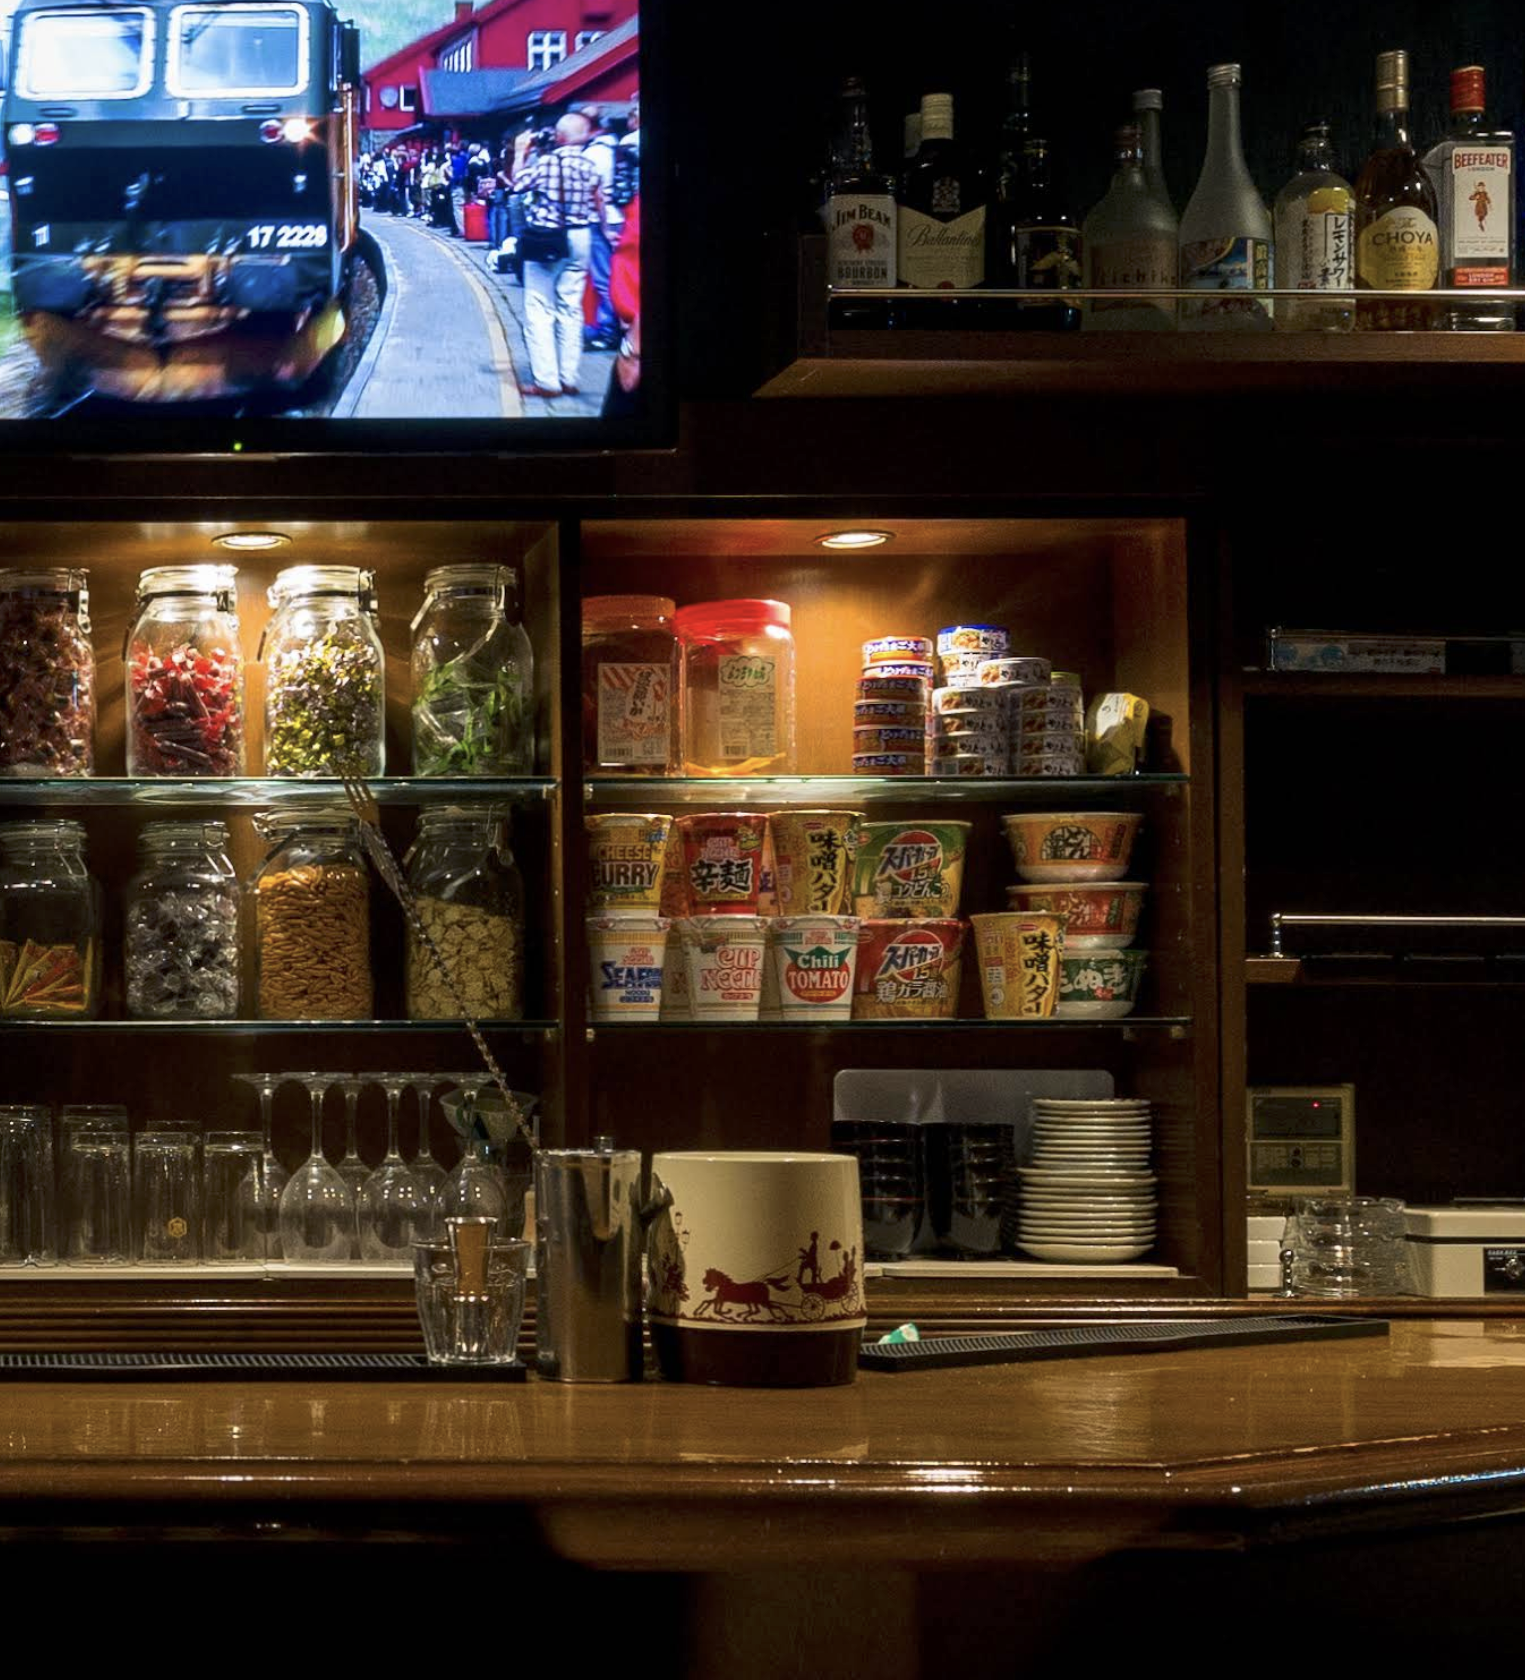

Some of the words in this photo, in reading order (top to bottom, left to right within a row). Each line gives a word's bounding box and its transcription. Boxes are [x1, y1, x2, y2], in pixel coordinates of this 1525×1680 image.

[1454, 152, 1508, 169] BEEFEATER
[837, 209, 856, 227] JIM
[246, 224, 275, 248] 17
[1372, 230, 1434, 245] CHOYA
[1332, 216, 1348, 288] レモンサワー
[838, 266, 888, 279] BOURBON
[597, 844, 652, 860] CHEESE
[591, 862, 659, 888] CURRY
[691, 859, 753, 893] 辛麺
[716, 947, 761, 969] CUP
[796, 954, 840, 969] Chili
[877, 945, 942, 977] スーパーカップ
[787, 970, 849, 989] TOMATO
